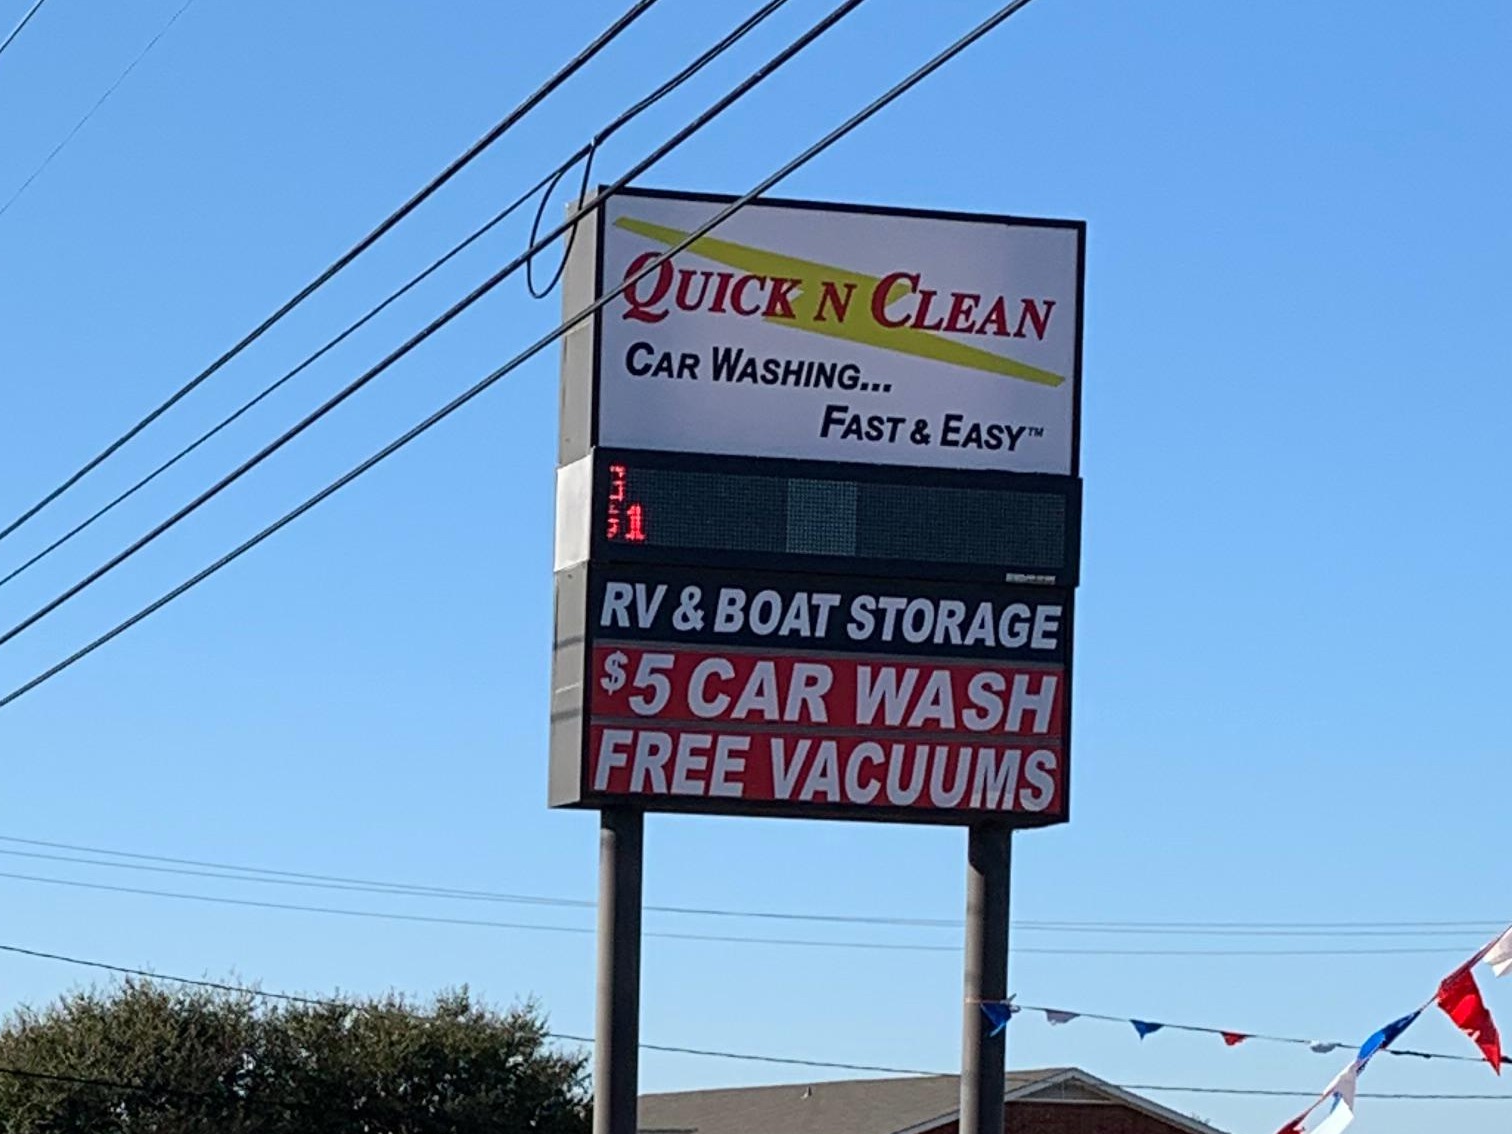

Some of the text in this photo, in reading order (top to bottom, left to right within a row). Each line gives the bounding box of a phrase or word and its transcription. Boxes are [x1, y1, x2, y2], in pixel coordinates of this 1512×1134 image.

[623, 252, 1056, 340] QUICK N CLEAN
[626, 342, 893, 392] CAR WASHING...
[820, 405, 908, 443] FAST
[910, 419, 931, 445] &
[600, 581, 1062, 650] RV & BOAT STORAGE
[600, 650, 1058, 733] $5 CAR WASH
[594, 729, 1057, 812] FREE VACUUMS
